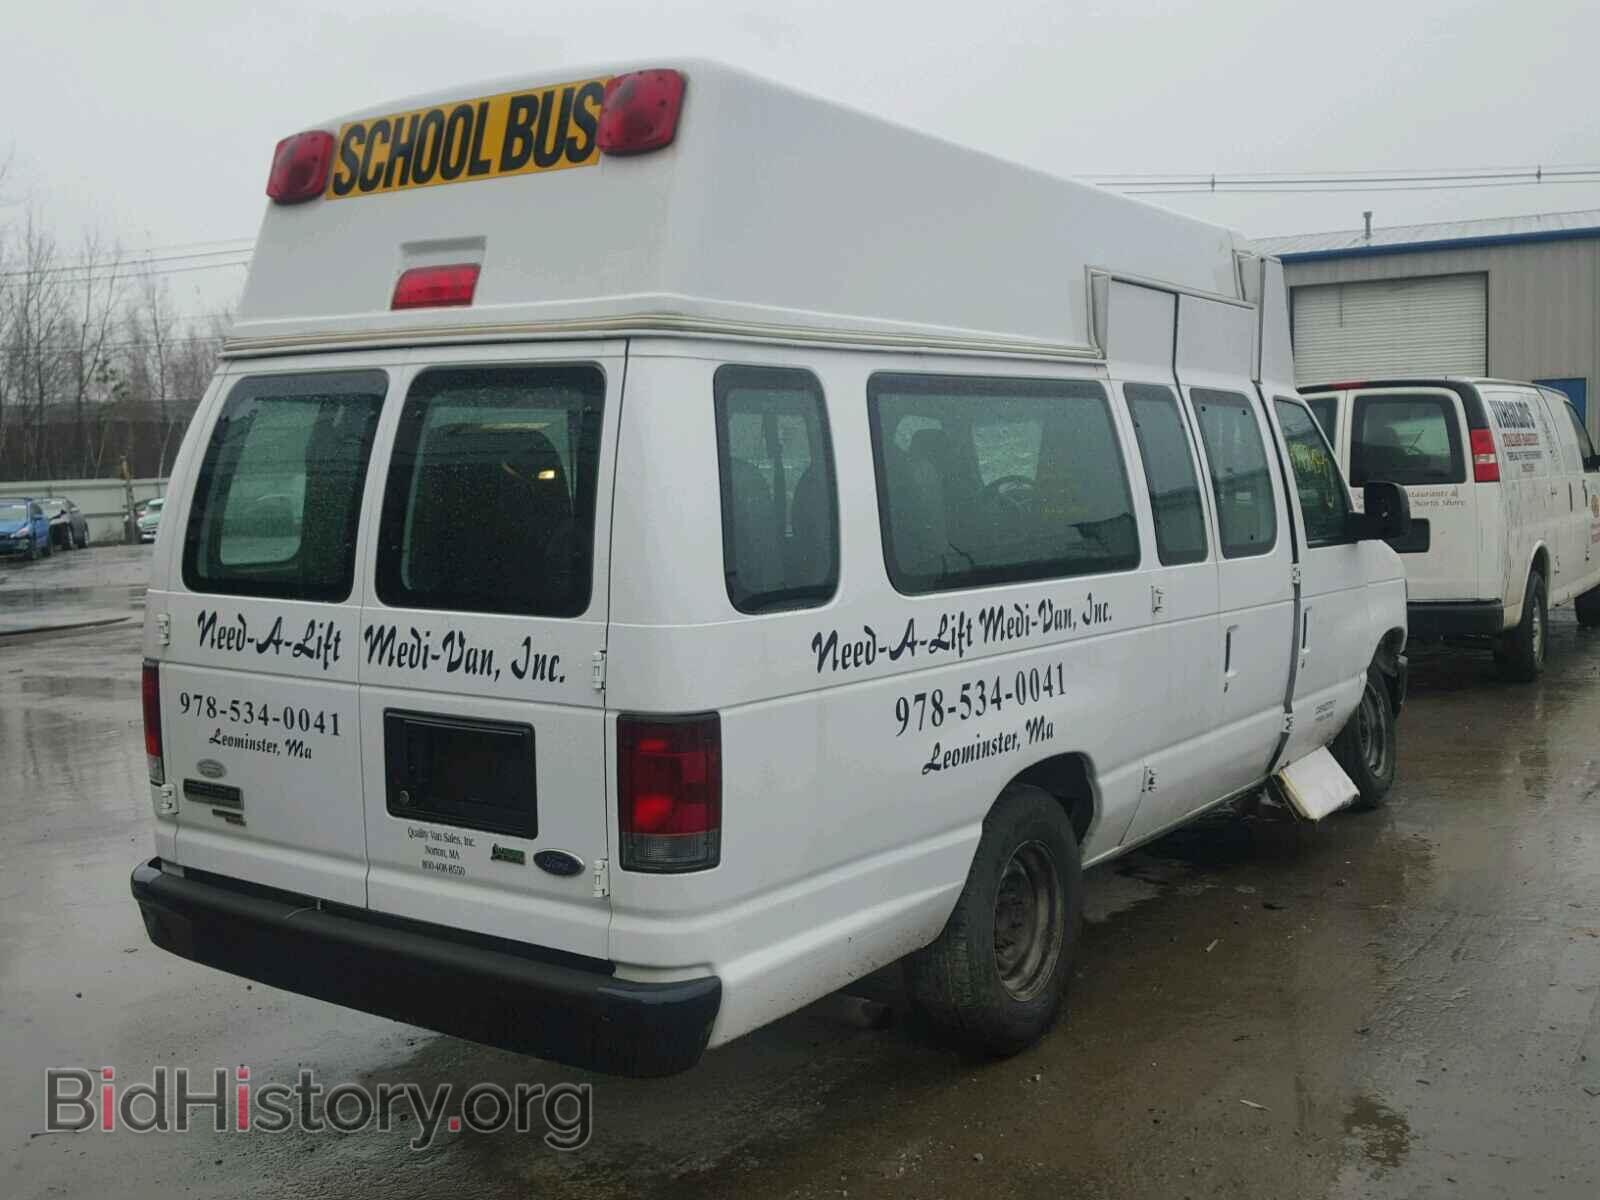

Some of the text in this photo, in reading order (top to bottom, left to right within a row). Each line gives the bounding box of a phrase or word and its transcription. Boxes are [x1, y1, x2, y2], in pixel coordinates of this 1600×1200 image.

[333, 80, 603, 196] SCHOOL BUS
[197, 610, 566, 684] Need-A-Lift Medi-Van, Inc.
[811, 592, 1112, 673] Need-A-Lift Medi-Van, Inc.
[179, 692, 342, 737] 978-534-0041
[895, 662, 1066, 738] 978-534-0041
[208, 728, 312, 760] Leominster, Ma
[921, 715, 1054, 776] Leominster, Ma
